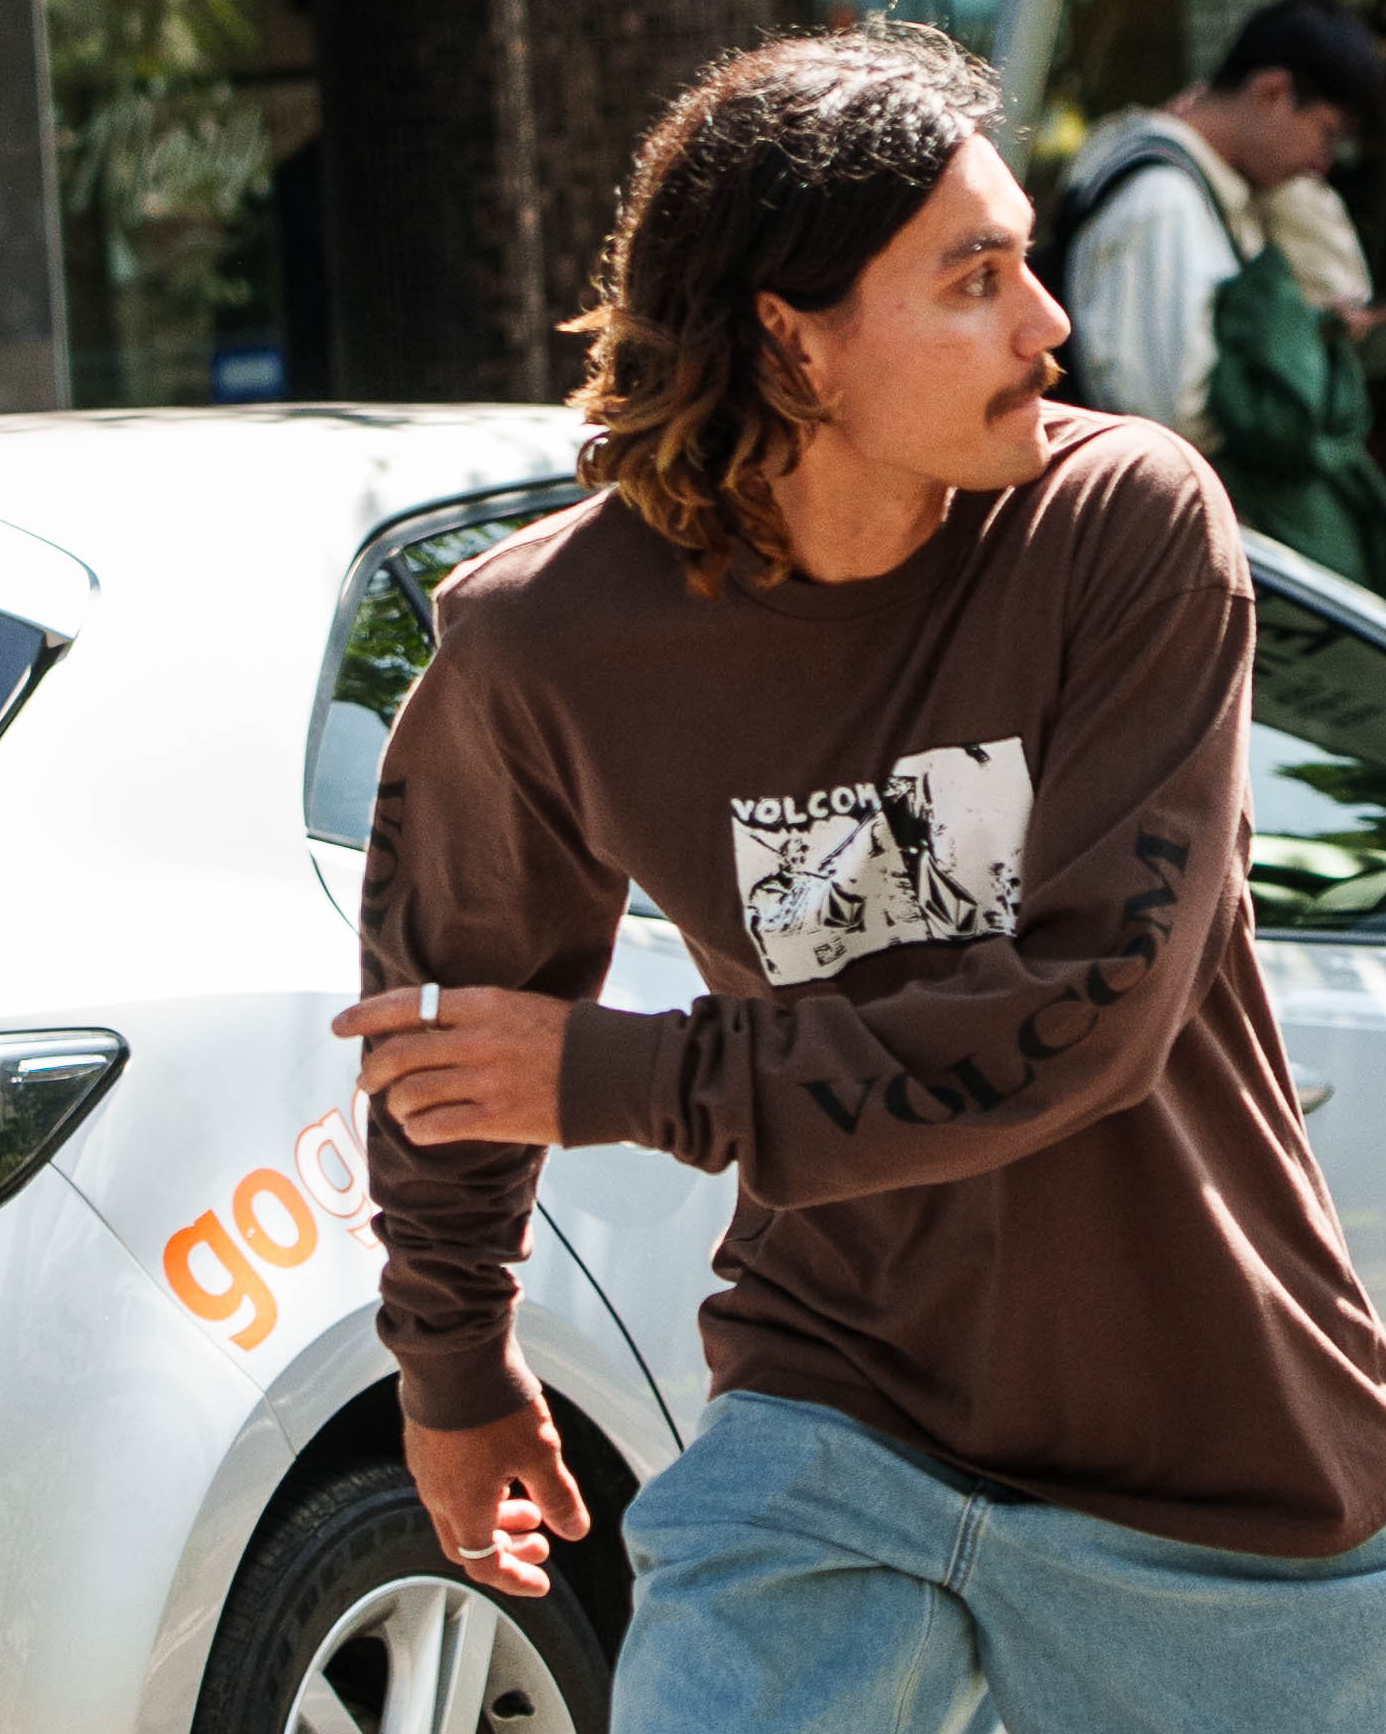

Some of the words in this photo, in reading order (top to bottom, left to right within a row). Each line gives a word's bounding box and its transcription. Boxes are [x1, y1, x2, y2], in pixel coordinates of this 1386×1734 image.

[732, 782, 882, 829] VOLCOM
[799, 827, 1193, 1135] VOLCOM
[163, 1087, 384, 1352] gog
